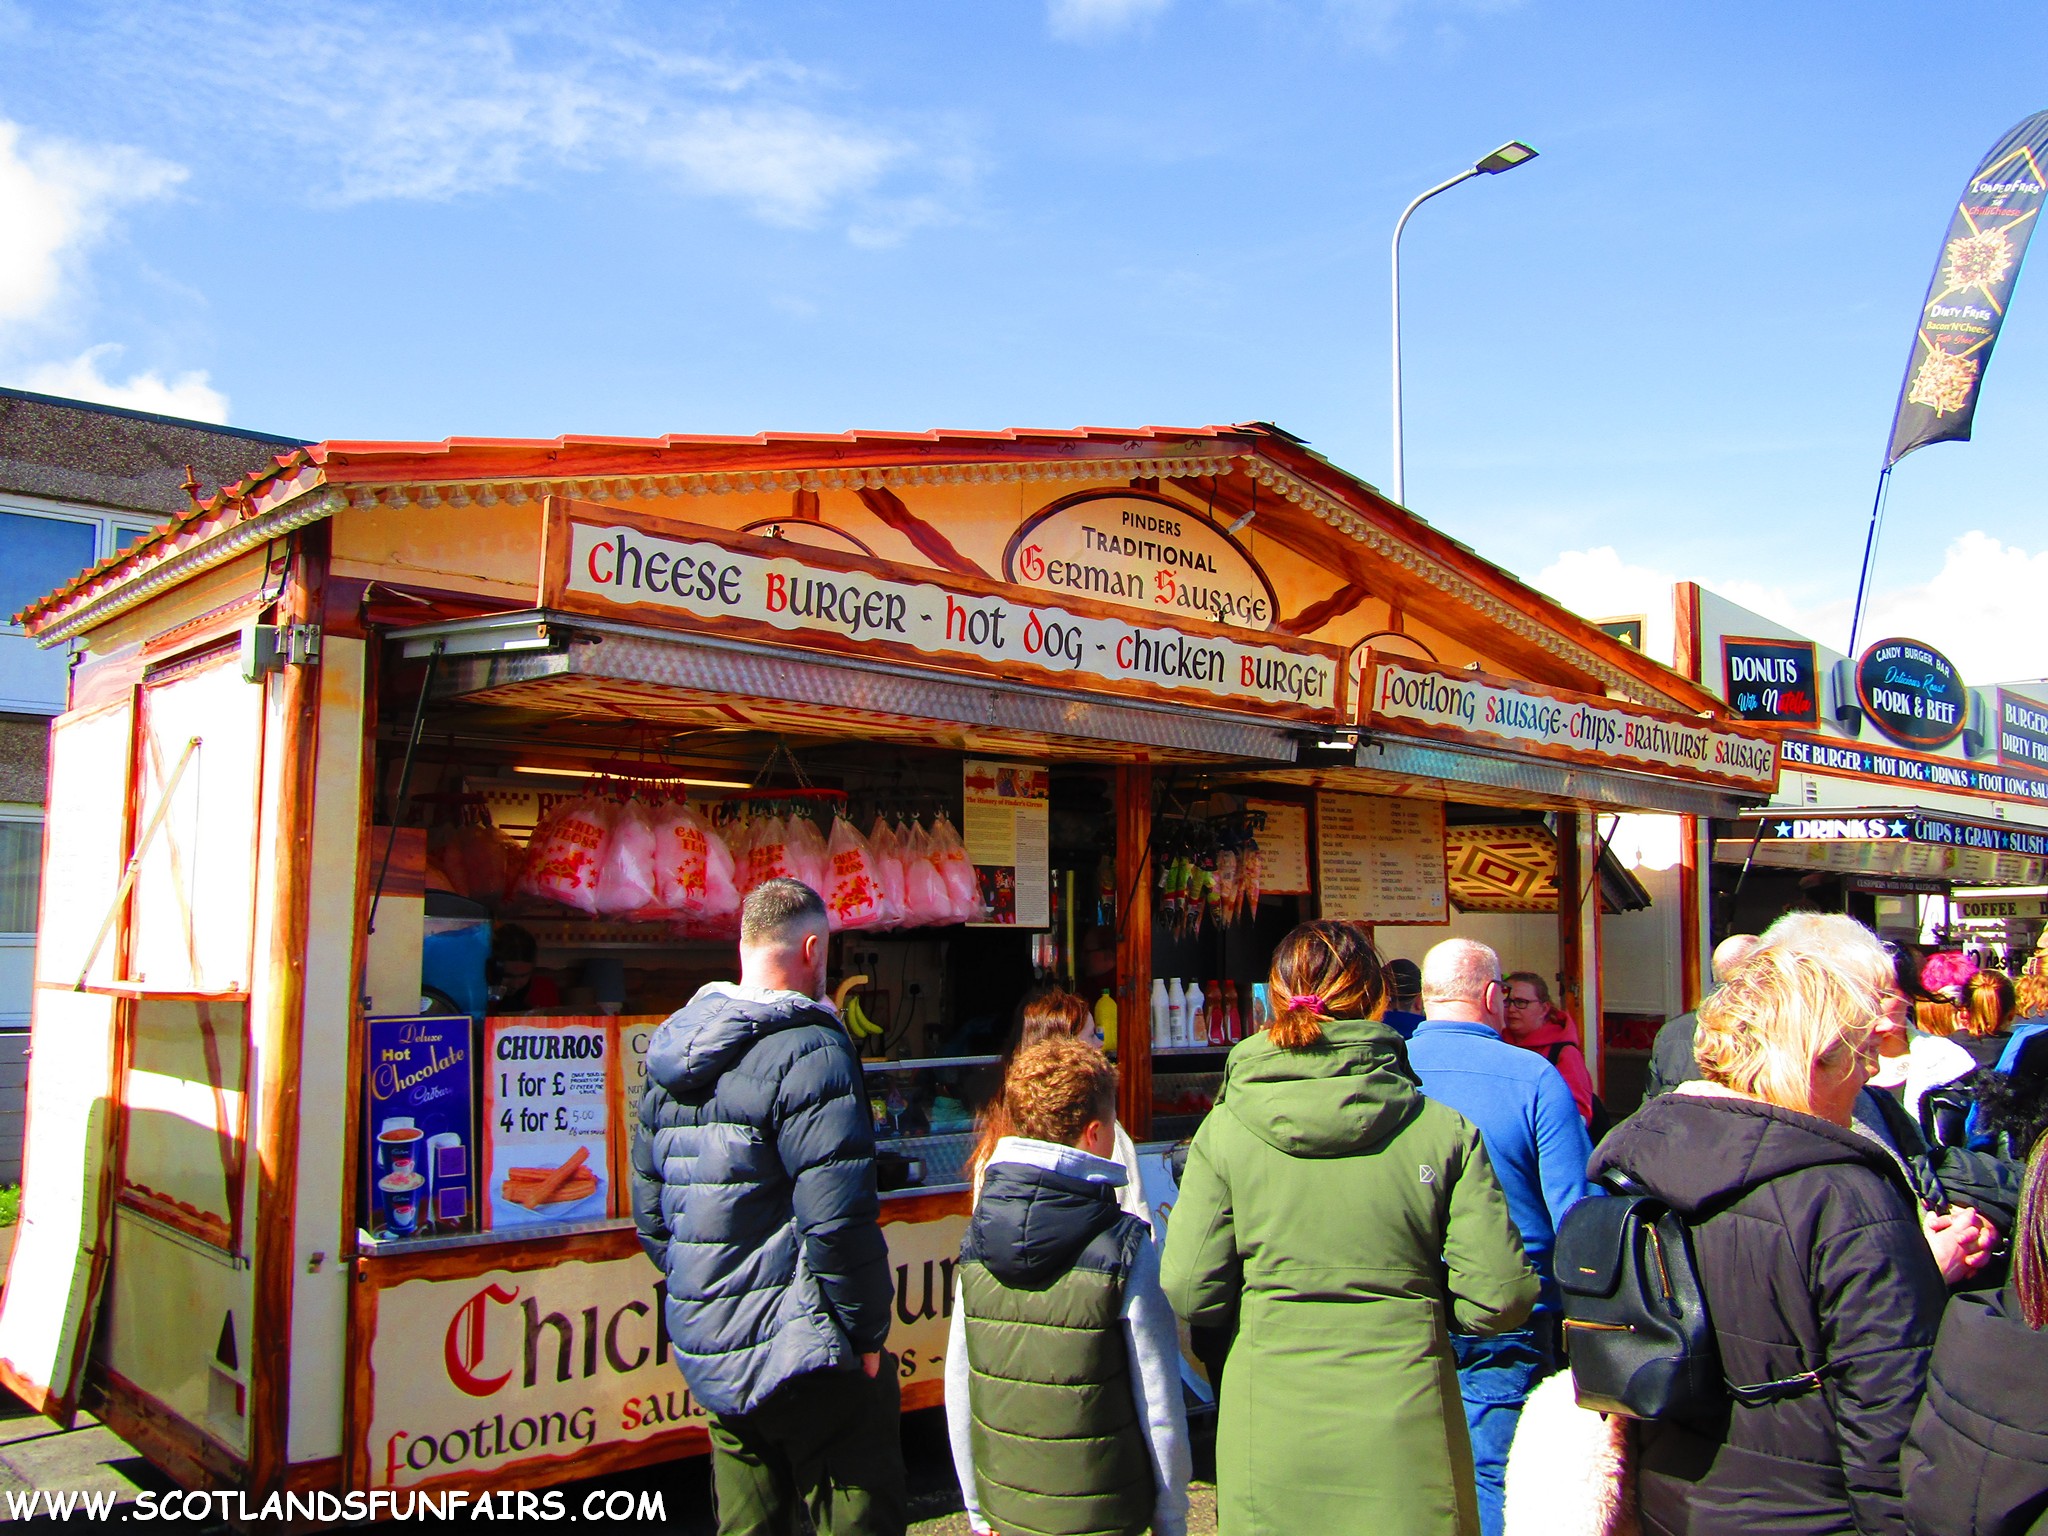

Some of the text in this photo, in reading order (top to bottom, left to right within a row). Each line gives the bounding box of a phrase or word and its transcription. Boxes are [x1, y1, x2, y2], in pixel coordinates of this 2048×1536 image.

[1122, 511, 1181, 537] PINDERS
[1082, 526, 1217, 574] TRADITIONAL
[1731, 656, 1797, 683] DONUTS
[1875, 646, 1950, 678] CANDY BURGER BAR
[1872, 687, 1956, 725] PORK & BEEF
[2002, 732, 2048, 763] DIRTY FRI
[1781, 740, 2048, 799] EESE BURGER HOT DOG DRINKS FOOT LONG SAU
[1792, 818, 1887, 839] DRINKS
[1914, 819, 2044, 855] CHIPS & GRAVY SLUSH
[1963, 902, 2017, 917] COFFEE
[399, 1024, 443, 1044] Deluxe
[497, 1035, 603, 1060] CHURROS
[382, 1048, 411, 1061] Hot
[372, 1044, 464, 1100] Chocolate
[501, 1072, 566, 1098] 1 for £
[500, 1106, 568, 1133] 4 for £
